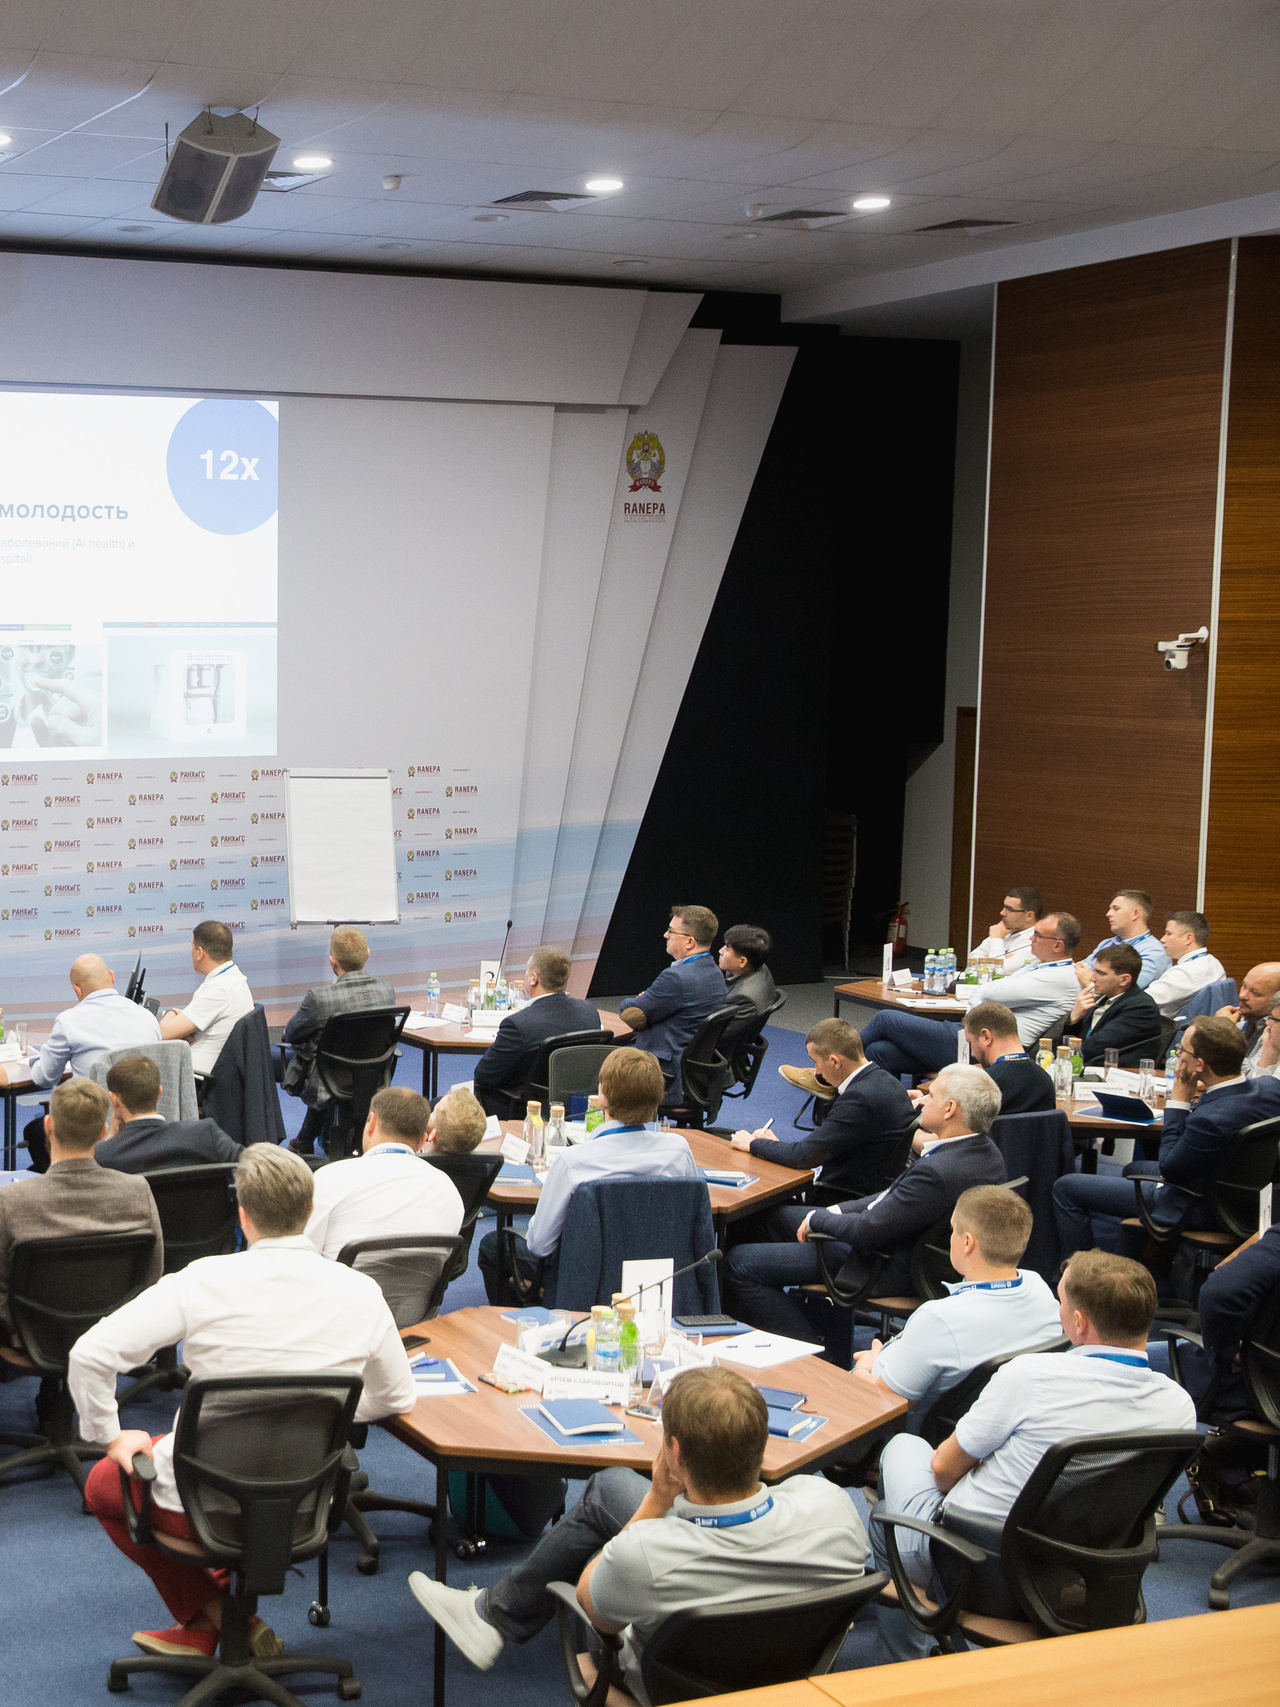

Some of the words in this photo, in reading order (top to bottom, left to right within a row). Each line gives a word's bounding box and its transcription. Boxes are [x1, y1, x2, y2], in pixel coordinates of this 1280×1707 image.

[200, 449, 260, 481] 12x
[624, 502, 666, 515] RANEPA
[71, 537, 86, 550] (AI
[88, 537, 126, 550] health)
[128, 540, 135, 549] и
[416, 765, 441, 773] RANEPA
[11, 773, 39, 782] РАНХиГС
[96, 772, 123, 780] RANEPA
[180, 771, 205, 779] РАНХиГС
[454, 785, 478, 793] RANEPA
[54, 795, 81, 803] РАНХиГС
[138, 793, 165, 802] RANEPA
[221, 792, 245, 800] РАНХиГС
[416, 807, 441, 816] RANEPA
[179, 814, 206, 823] РАНХиГС
[260, 812, 286, 820] RANEPA
[12, 819, 38, 827] РАНХиГС
[96, 816, 123, 825] RANEPA
[454, 827, 478, 835] RANEPA
[138, 837, 164, 846] RANEPA
[220, 834, 246, 843] РАНХиГС
[54, 839, 81, 848] РАНХиГС
[416, 849, 440, 858] RANEPA
[180, 858, 204, 866] РАНХиГС
[260, 855, 286, 863] RANEPA
[11, 863, 39, 871] РАНХиГС
[96, 860, 123, 869] RANEPA
[453, 868, 478, 877] RANEPA
[138, 881, 164, 889] RANEPA
[221, 878, 245, 886] РАНХиГС
[55, 884, 80, 892] РАНХиГС
[415, 891, 440, 899] RANEPA
[180, 902, 204, 910] РАНХиГС
[261, 898, 284, 906] RANEPA
[12, 908, 38, 917] РАНХиГС
[96, 904, 123, 913] RANEPA
[453, 910, 477, 919] RANEPA
[54, 928, 81, 936] РАНХиГС
[138, 924, 164, 933] RANEPA
